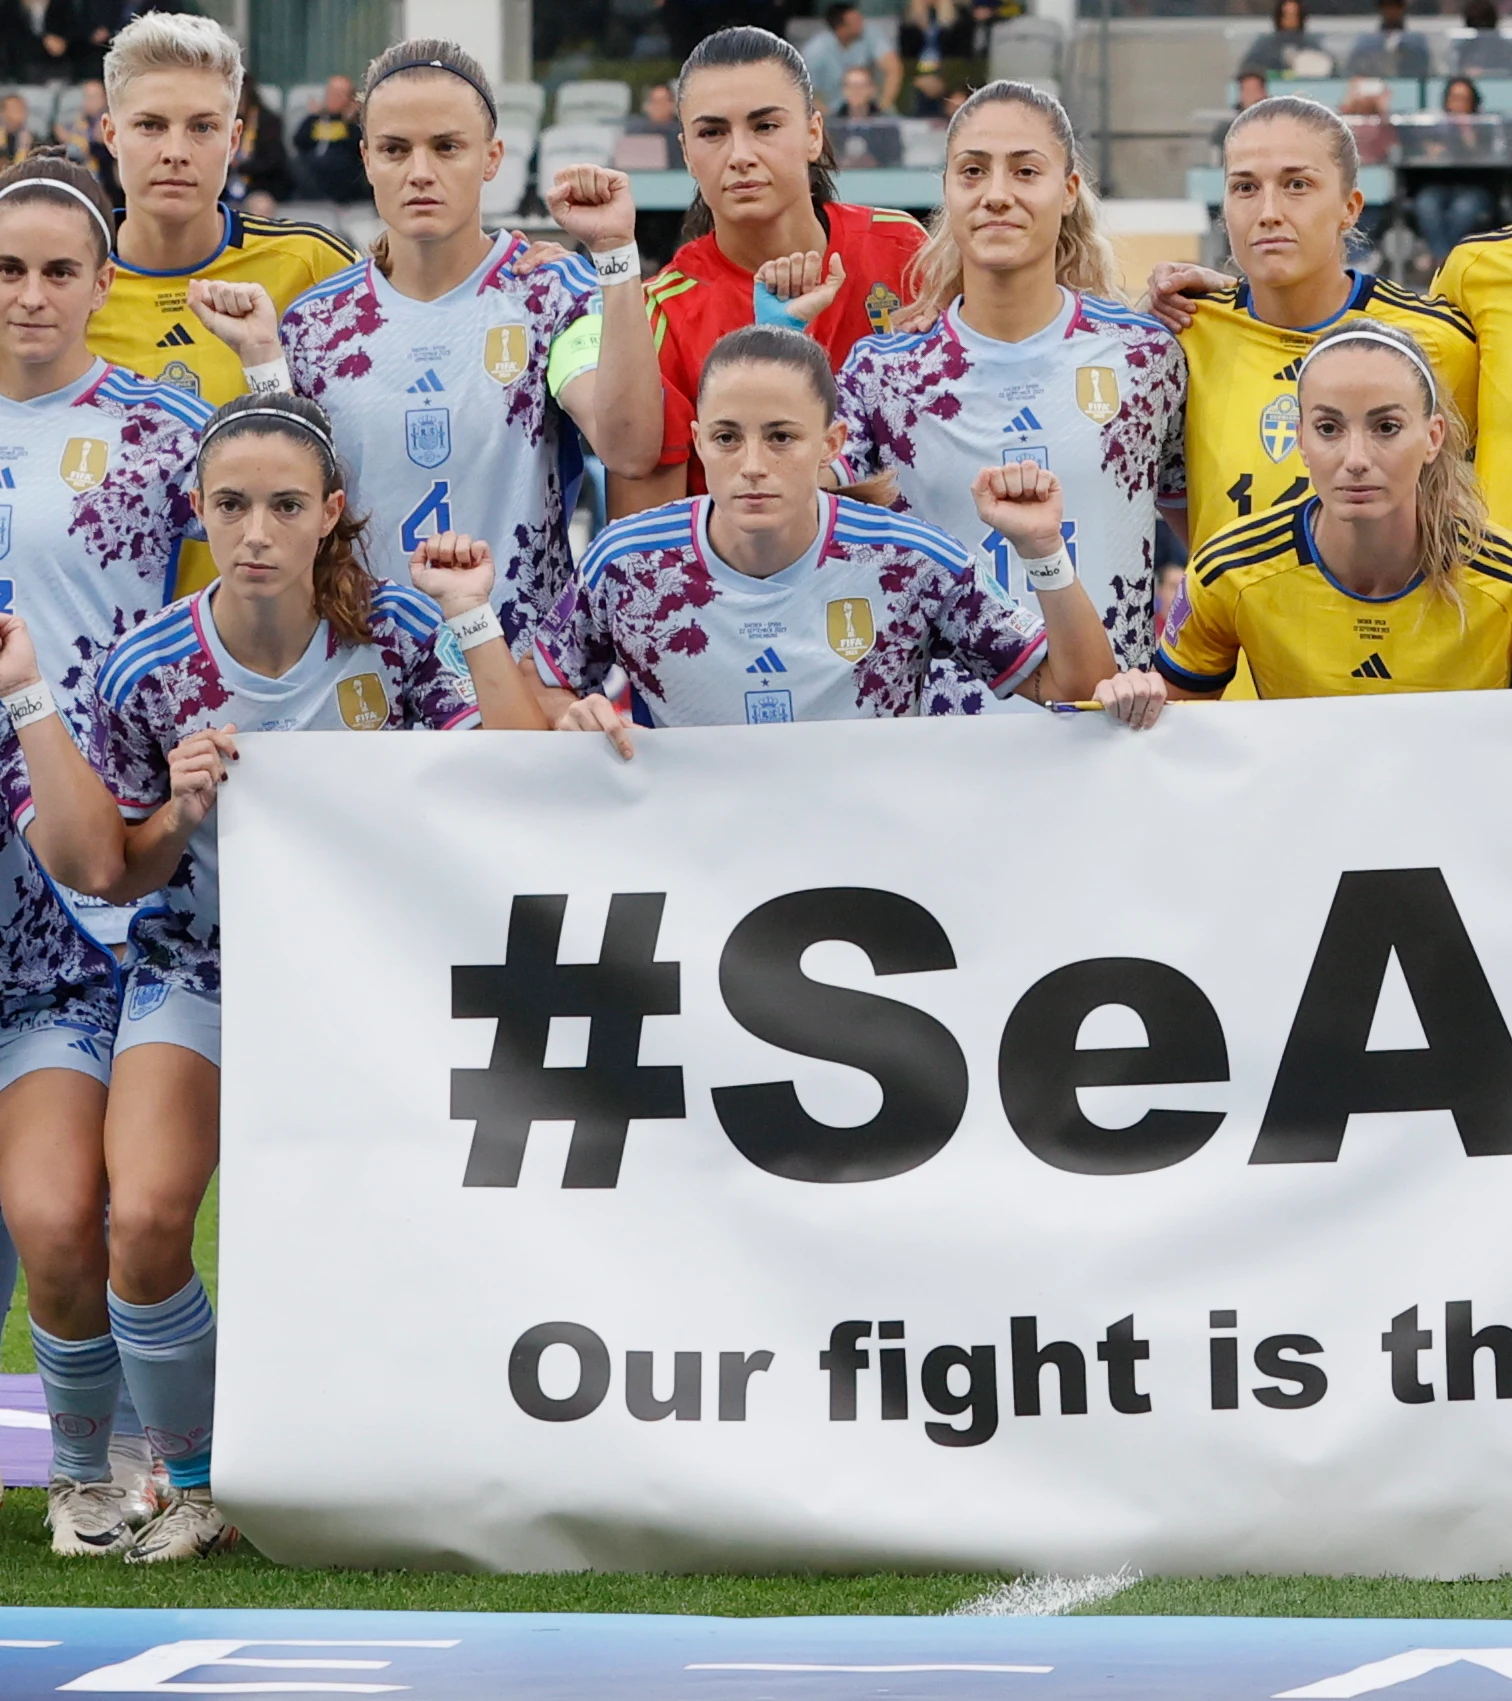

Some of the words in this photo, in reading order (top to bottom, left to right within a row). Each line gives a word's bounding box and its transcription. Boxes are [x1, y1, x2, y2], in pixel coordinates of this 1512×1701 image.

[399, 479, 452, 555] 4
[840, 637, 863, 648] FIFA
[509, 1322, 774, 1422] Our
[820, 1312, 1151, 1447] fight
[1210, 1310, 1327, 1410] is
